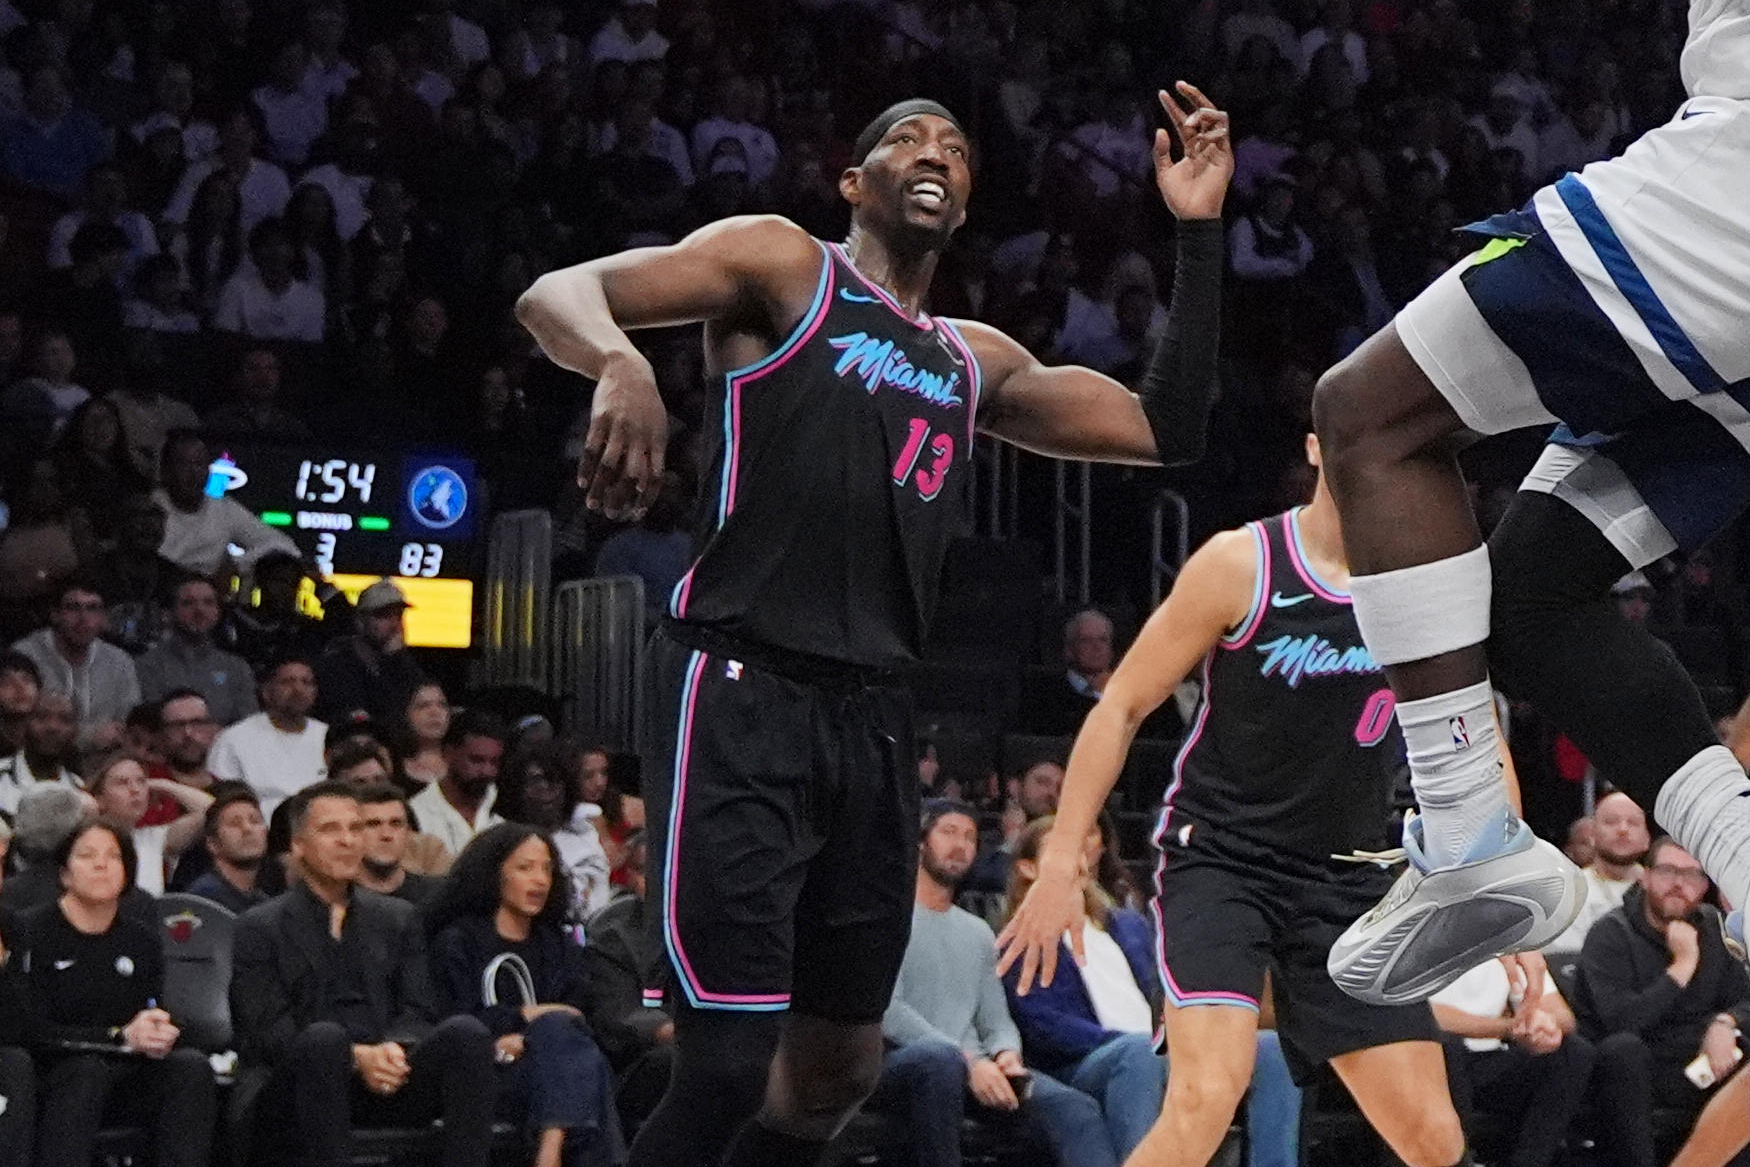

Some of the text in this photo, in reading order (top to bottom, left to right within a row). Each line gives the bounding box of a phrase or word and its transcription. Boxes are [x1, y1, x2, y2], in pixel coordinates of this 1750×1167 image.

[829, 332, 963, 409] Miami
[296, 459, 377, 504] 1:54
[892, 417, 954, 502] 13
[399, 543, 444, 578] 83
[1255, 634, 1383, 689] Miam
[1355, 688, 1397, 747] 0
